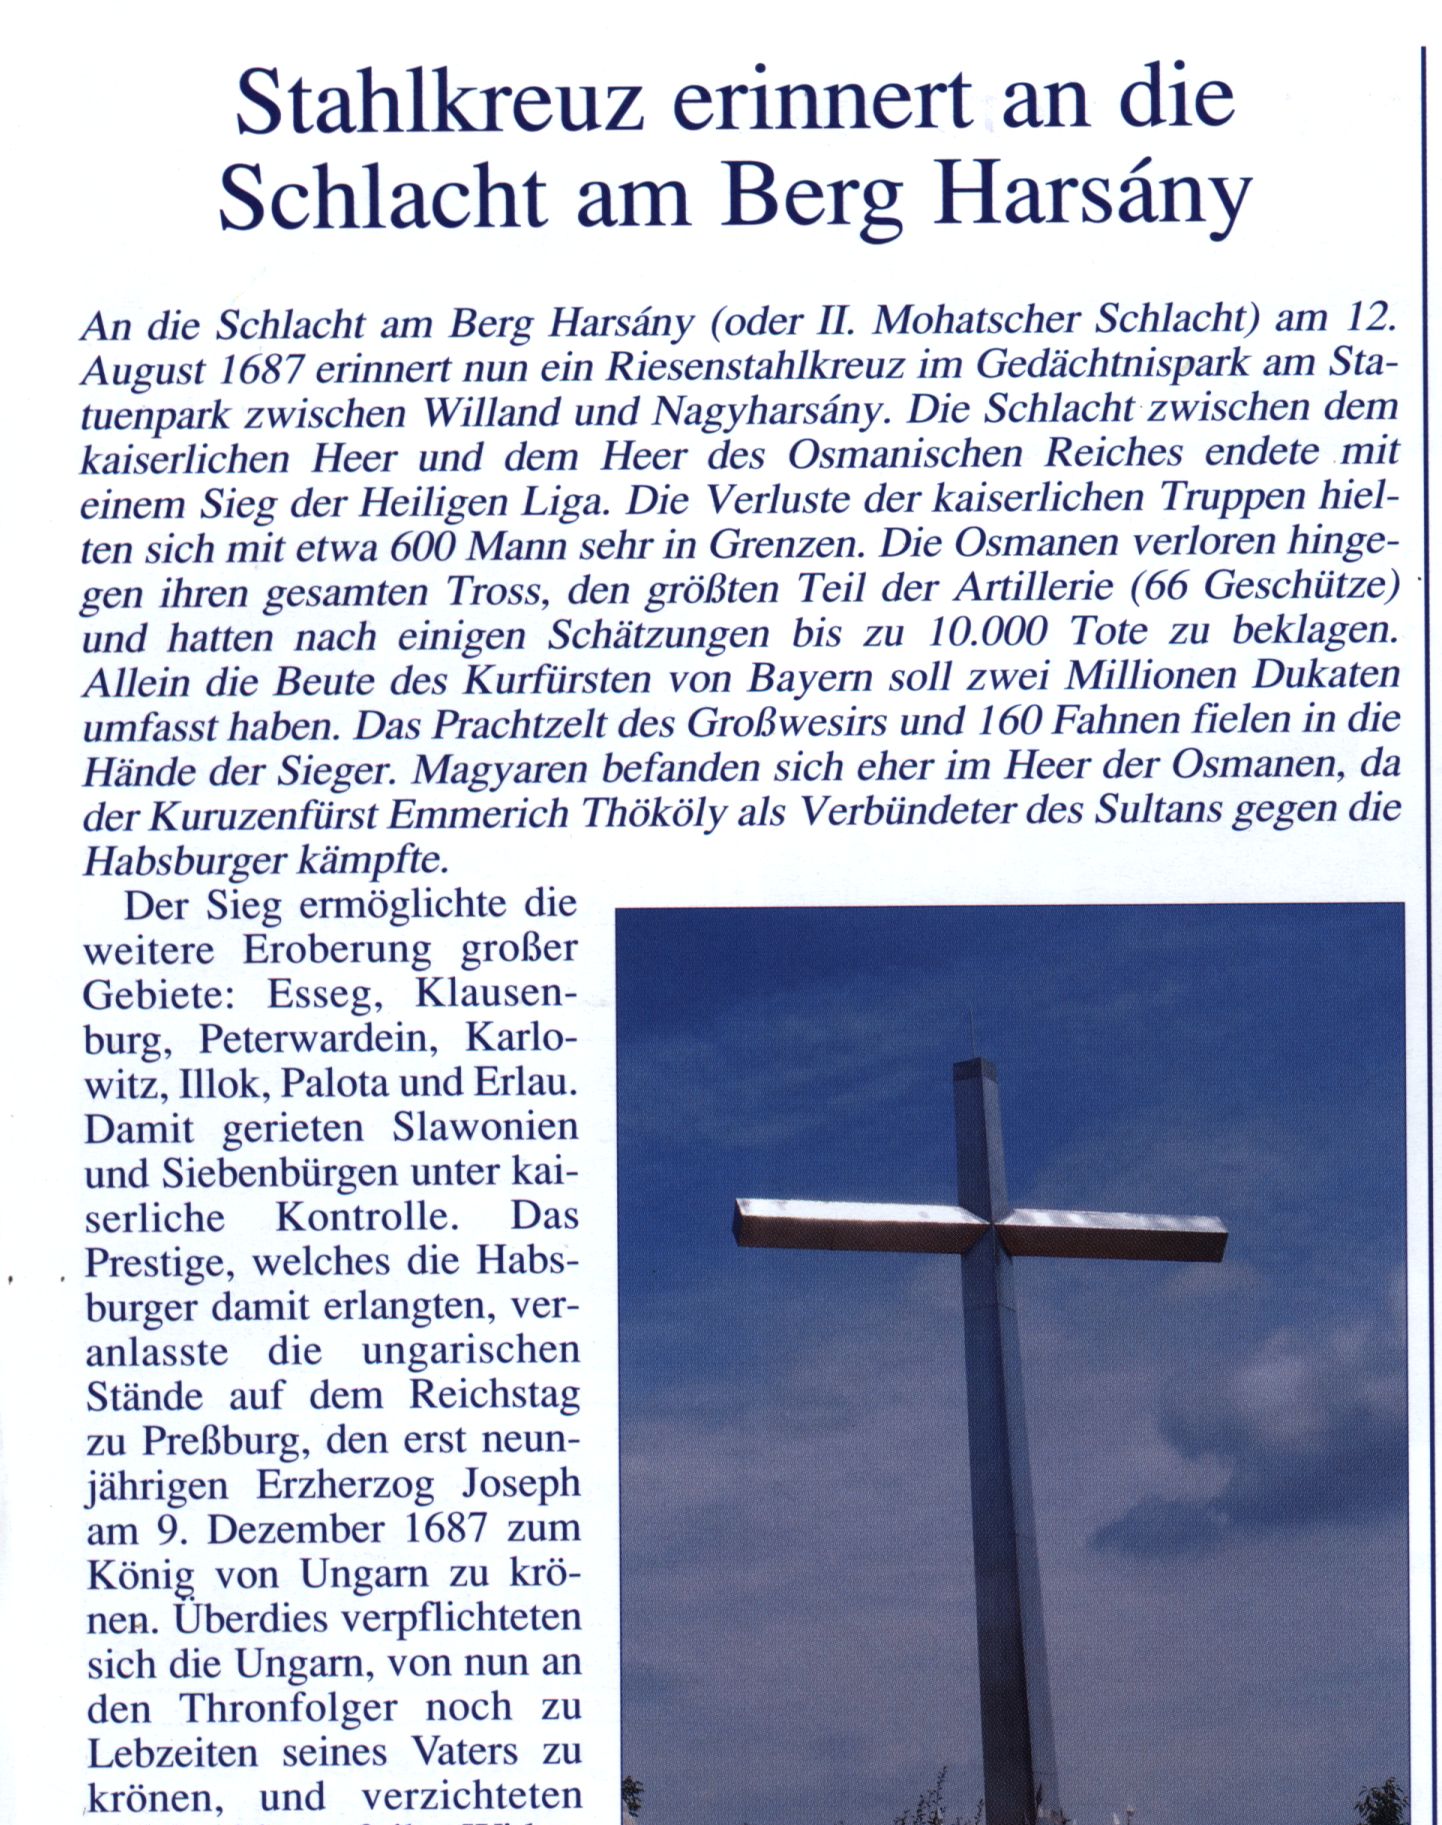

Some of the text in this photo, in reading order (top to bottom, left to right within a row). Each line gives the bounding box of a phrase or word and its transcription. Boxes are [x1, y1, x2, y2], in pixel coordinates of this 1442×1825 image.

[236, 59, 1235, 135] Stahlkreuz erinnert an die
[219, 155, 1254, 245] Schlacht am Berg Harsány
[78, 299, 1396, 347] An die Schlacht am Berg Harsány (oder II. Mohatscher Schlacht) am 12.
[79, 433, 1402, 475] kaiserlichen Heer und dem Heer des Osmanischen Reiches endete mit
[78, 567, 1400, 618] gen ihren gesamten Tross, den größten Teil der Artillerie (66 Geschütze)
[83, 700, 1401, 743] umfasst haben. Das Prachtzelt des Großwesirs und 160 Fahnen fielen in die
[124, 886, 577, 929] Der Sieg ermöglichte die
[82, 976, 577, 1017] Gebiete: Esseg, Klausen-
[84, 1065, 577, 1105] witz, Illok, Palota und Erlau.
[84, 1153, 579, 1196] und Siebenbürgen unter kai-
[86, 1332, 580, 1374] anlasste die ungarischen
[83, 1465, 581, 1510] jährigen Erzherzog Joseph
[87, 1511, 581, 1546] am 9. Dezember 1687 zum
[87, 1595, 582, 1641] nen. Überdies verpflichteten
[88, 1735, 582, 1769] Lebzeiten seines Vaters zu
